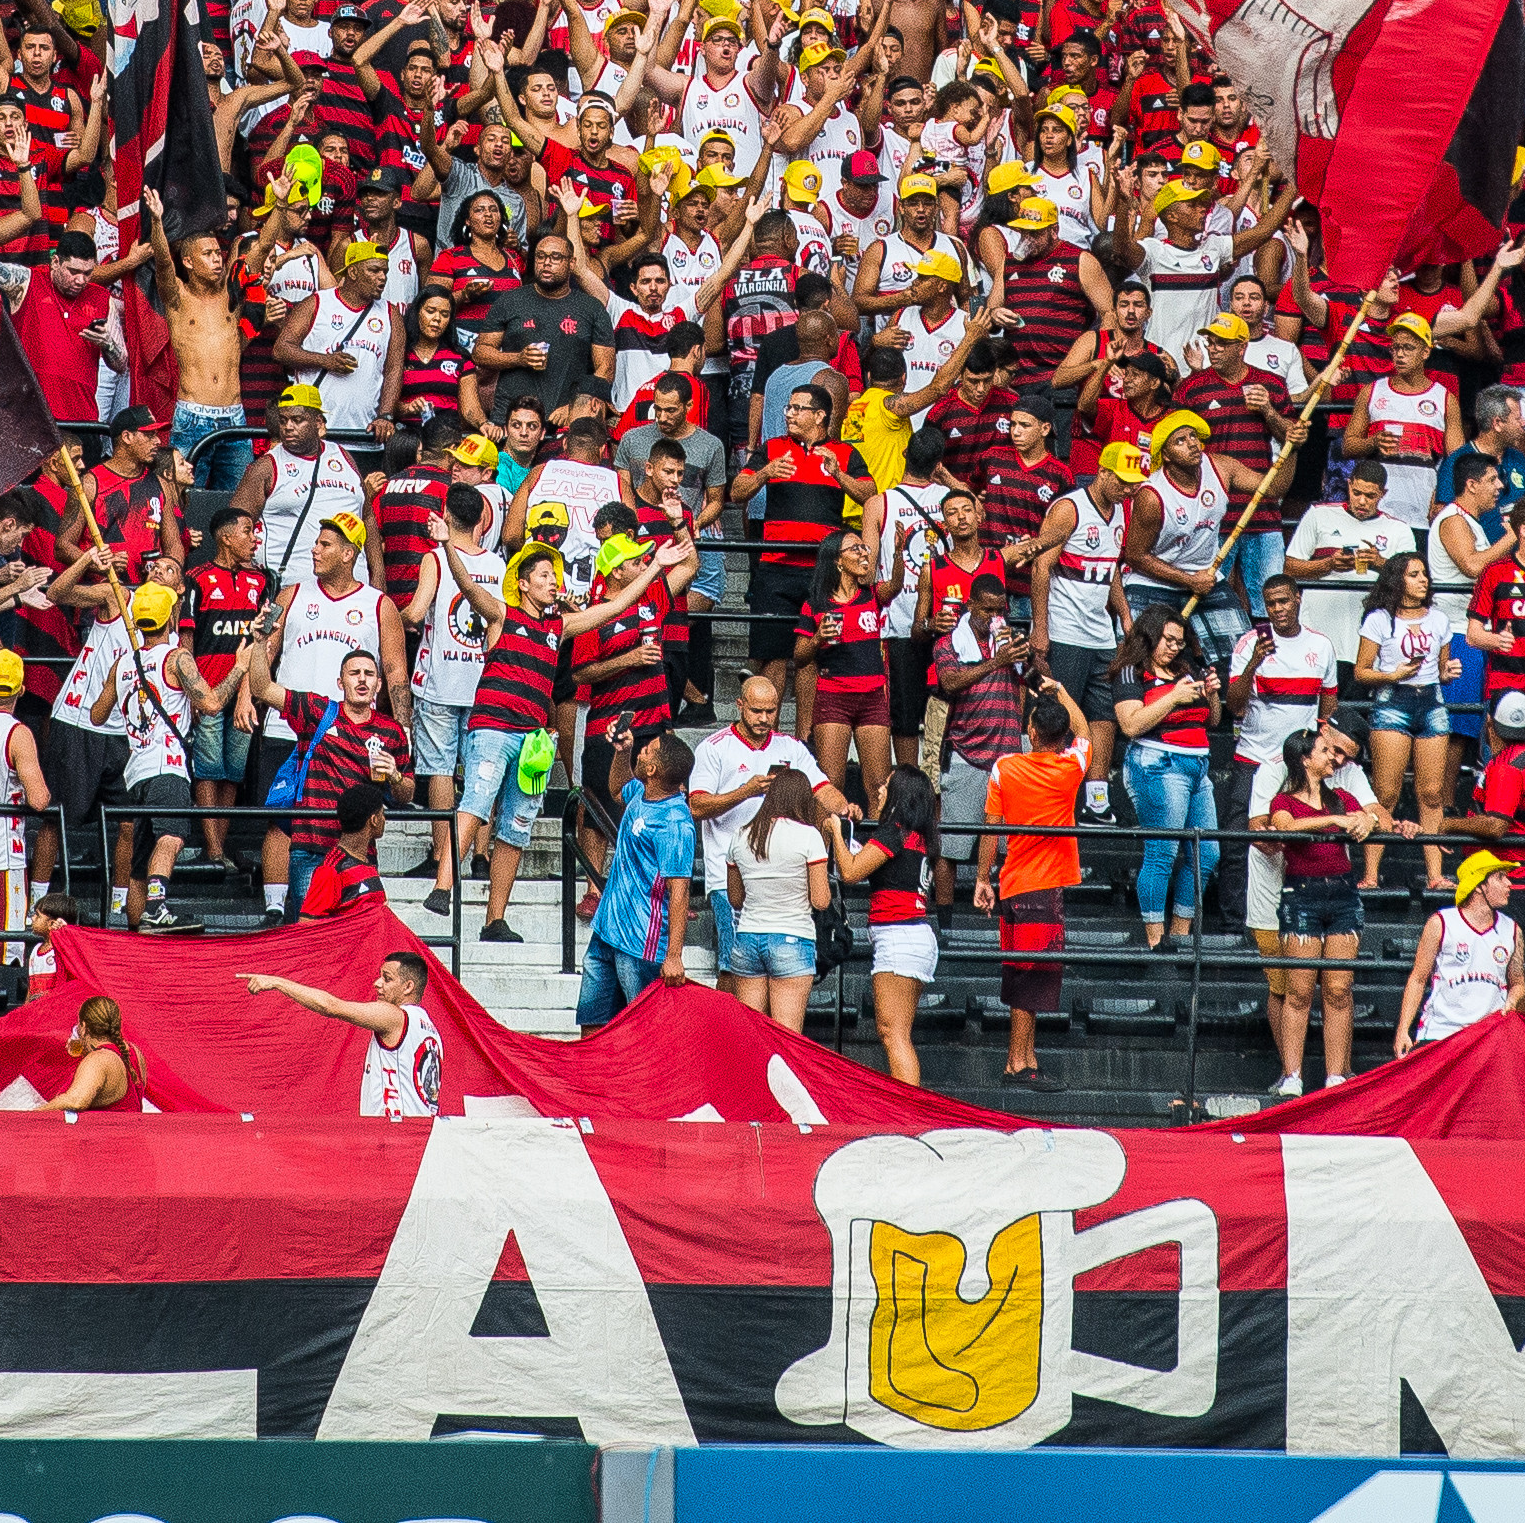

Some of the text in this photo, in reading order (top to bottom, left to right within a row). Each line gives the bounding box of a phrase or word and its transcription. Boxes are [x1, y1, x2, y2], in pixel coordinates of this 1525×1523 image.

[739, 268, 785, 283] FLA
[184, 402, 221, 417] Calvin
[385, 479, 431, 494] MRV
[534, 478, 616, 502] CASA
